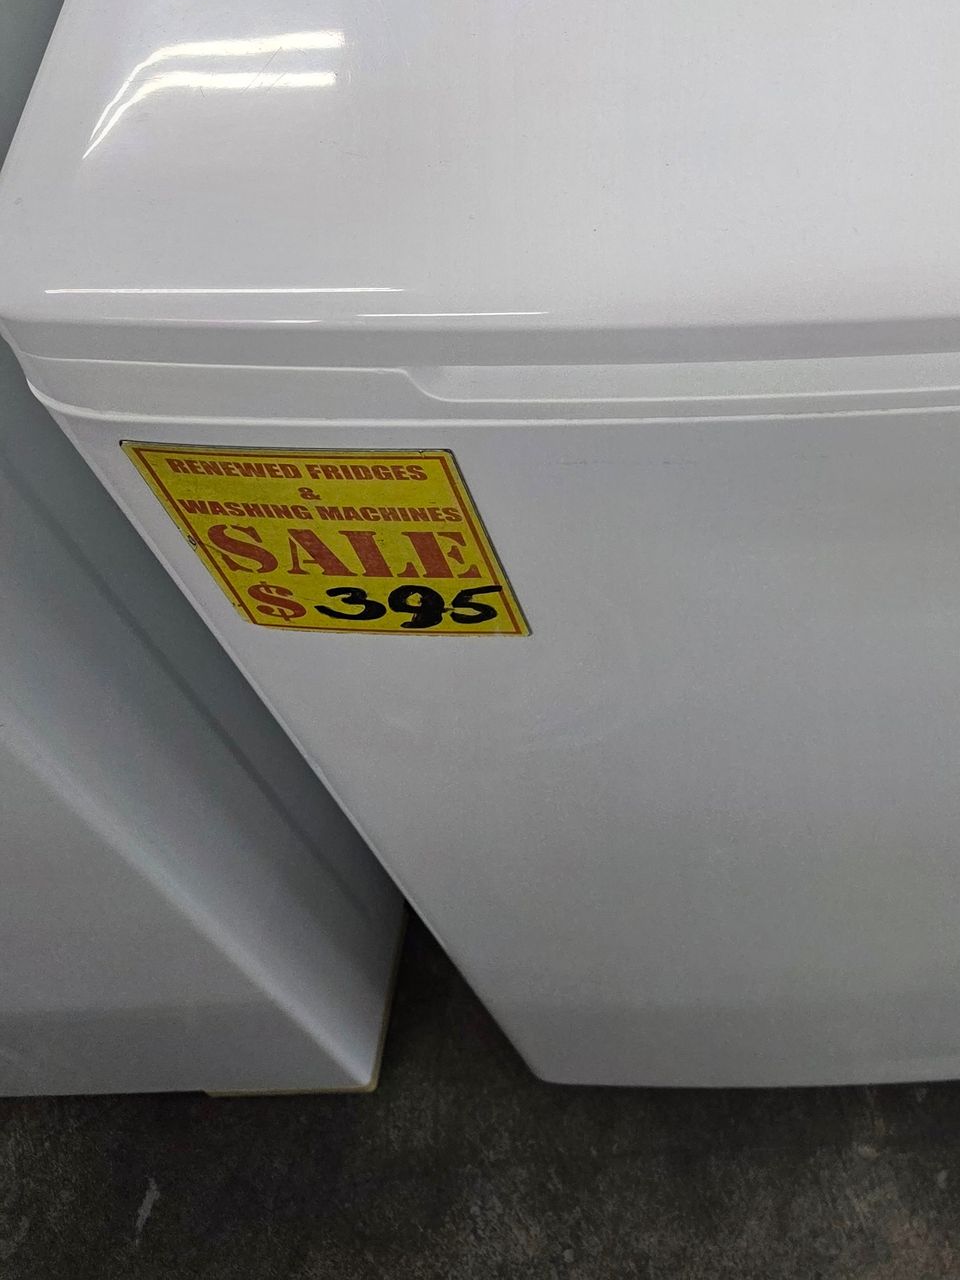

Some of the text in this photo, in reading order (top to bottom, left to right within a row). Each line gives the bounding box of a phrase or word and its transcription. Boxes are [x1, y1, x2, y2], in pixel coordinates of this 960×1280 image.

[166, 459, 428, 481] RENEWED FRIDGES
[298, 487, 320, 501] &
[178, 499, 462, 522] WASHING MACHINES
[206, 524, 482, 579] SALE
[248, 581, 502, 629] $ 395
